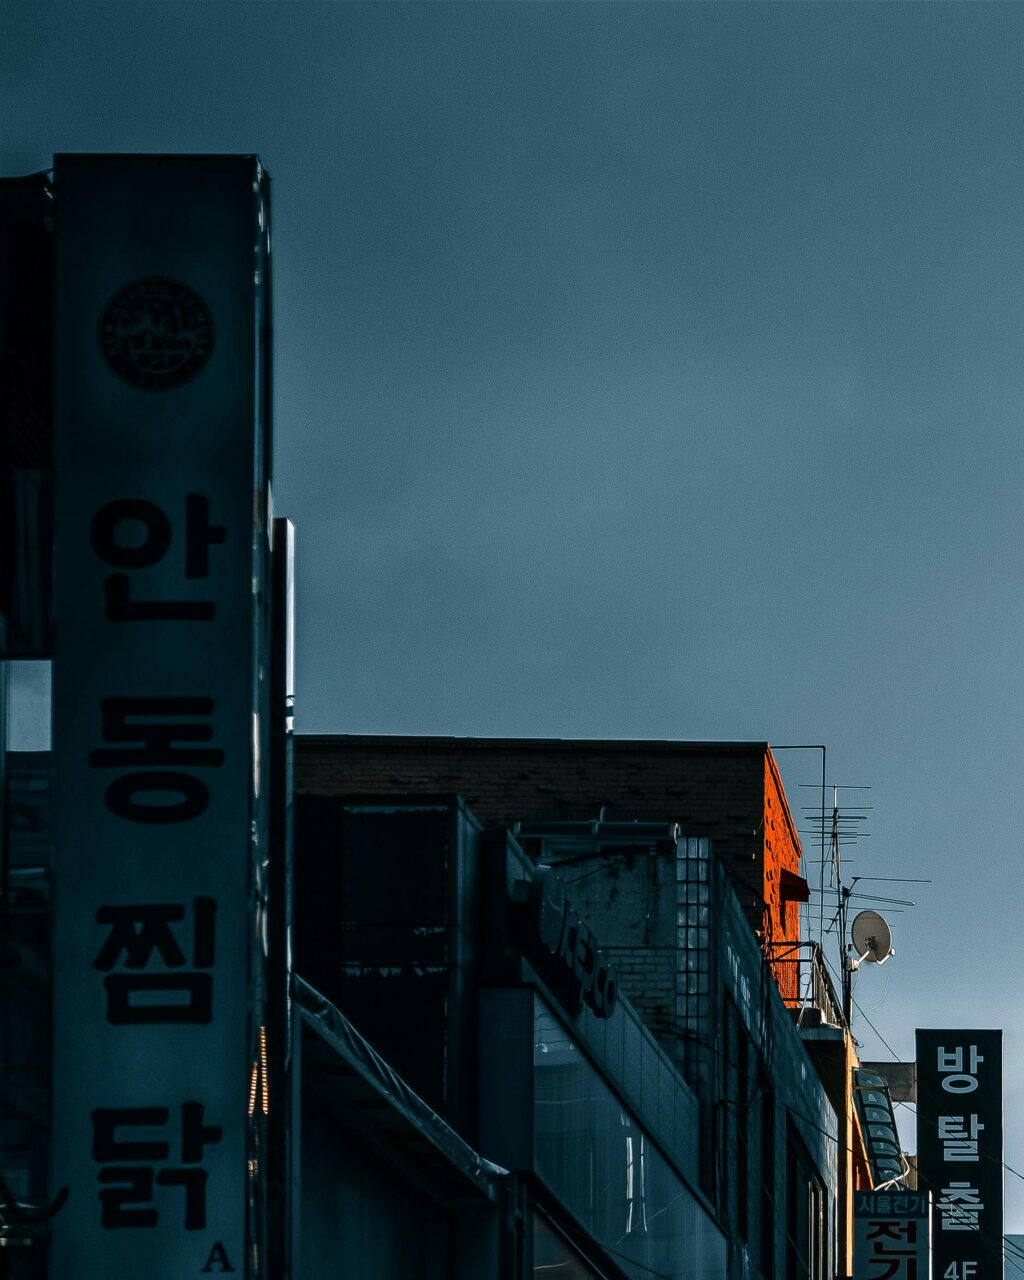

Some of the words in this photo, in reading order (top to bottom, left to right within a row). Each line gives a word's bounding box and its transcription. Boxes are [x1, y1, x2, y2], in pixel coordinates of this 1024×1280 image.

[88, 492, 228, 1230] 안동찜닭
[858, 1195, 926, 1214] 서울전기
[936, 1044, 984, 1231] 방탈출
